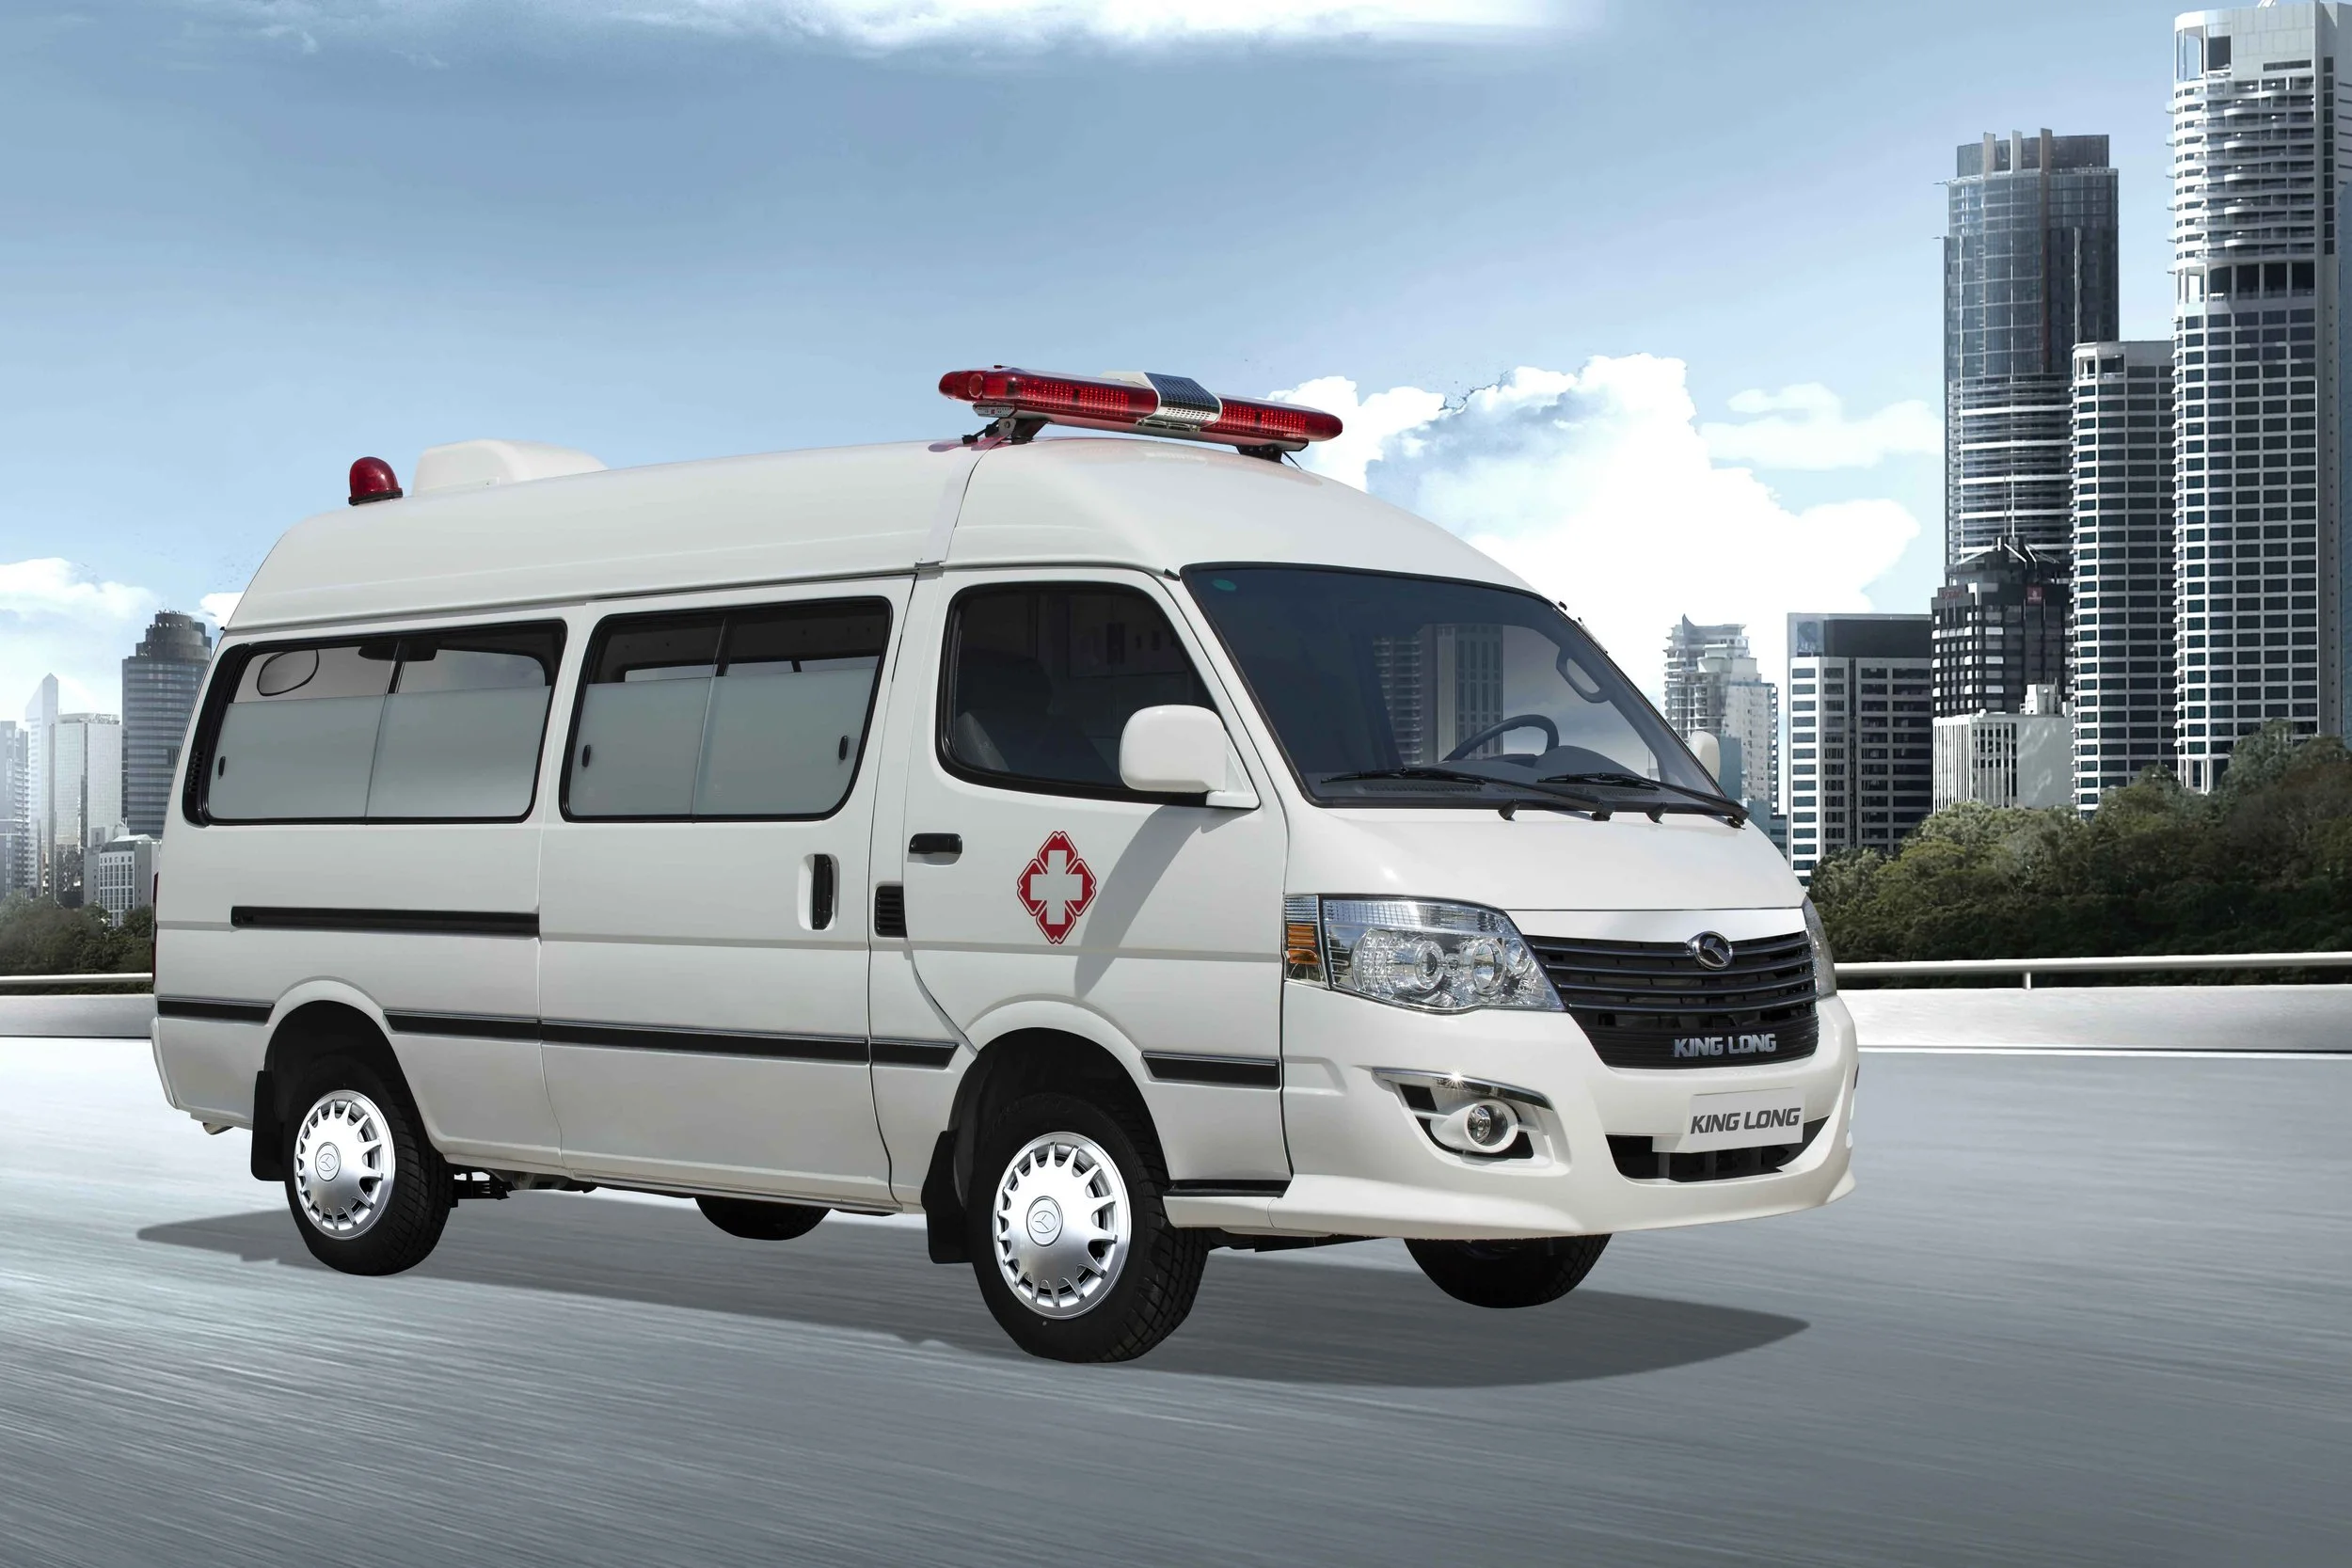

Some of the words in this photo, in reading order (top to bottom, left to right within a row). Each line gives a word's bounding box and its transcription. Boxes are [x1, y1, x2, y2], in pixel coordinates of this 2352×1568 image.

[1674, 1037, 1723, 1057] KING
[1728, 1033, 1776, 1054] LONG
[1691, 1112, 1740, 1134] KING
[1744, 1107, 1802, 1129] LONG
